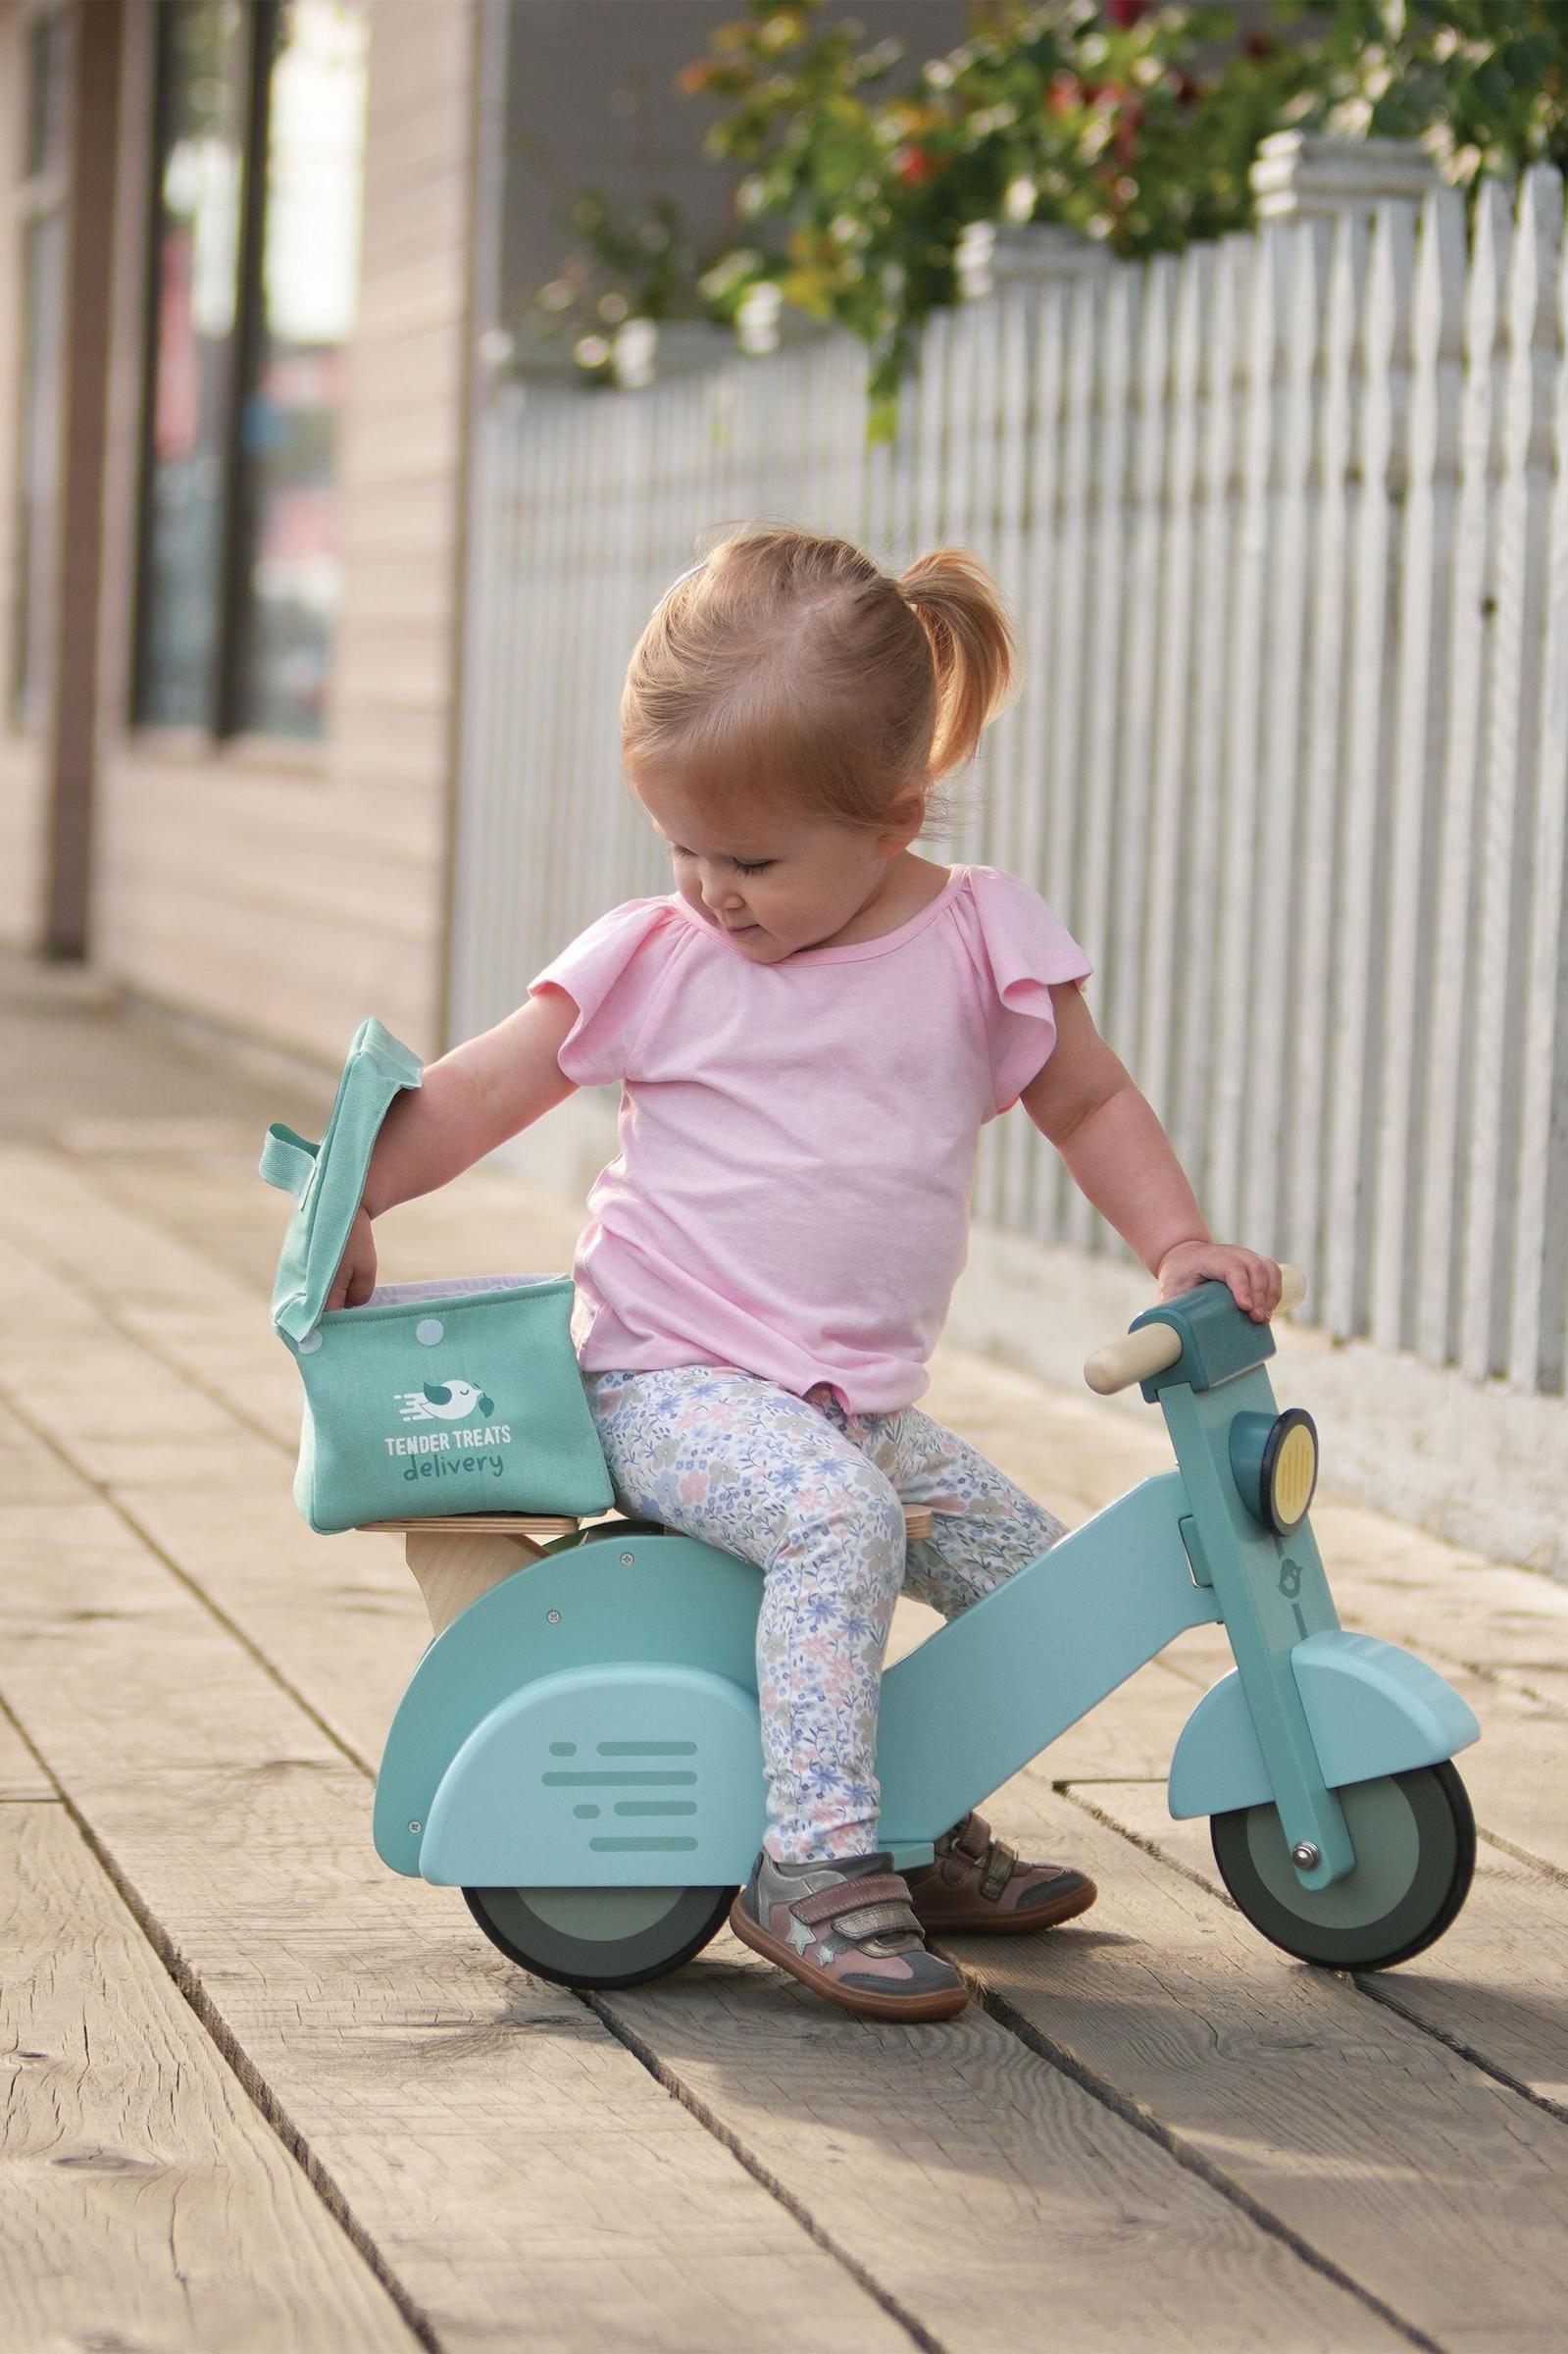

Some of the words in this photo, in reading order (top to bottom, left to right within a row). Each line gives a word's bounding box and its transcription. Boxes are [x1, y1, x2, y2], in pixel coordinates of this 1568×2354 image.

[384, 1432, 450, 1457] TENDER
[453, 1424, 511, 1449] TREATS
[403, 1452, 504, 1481] delivery
